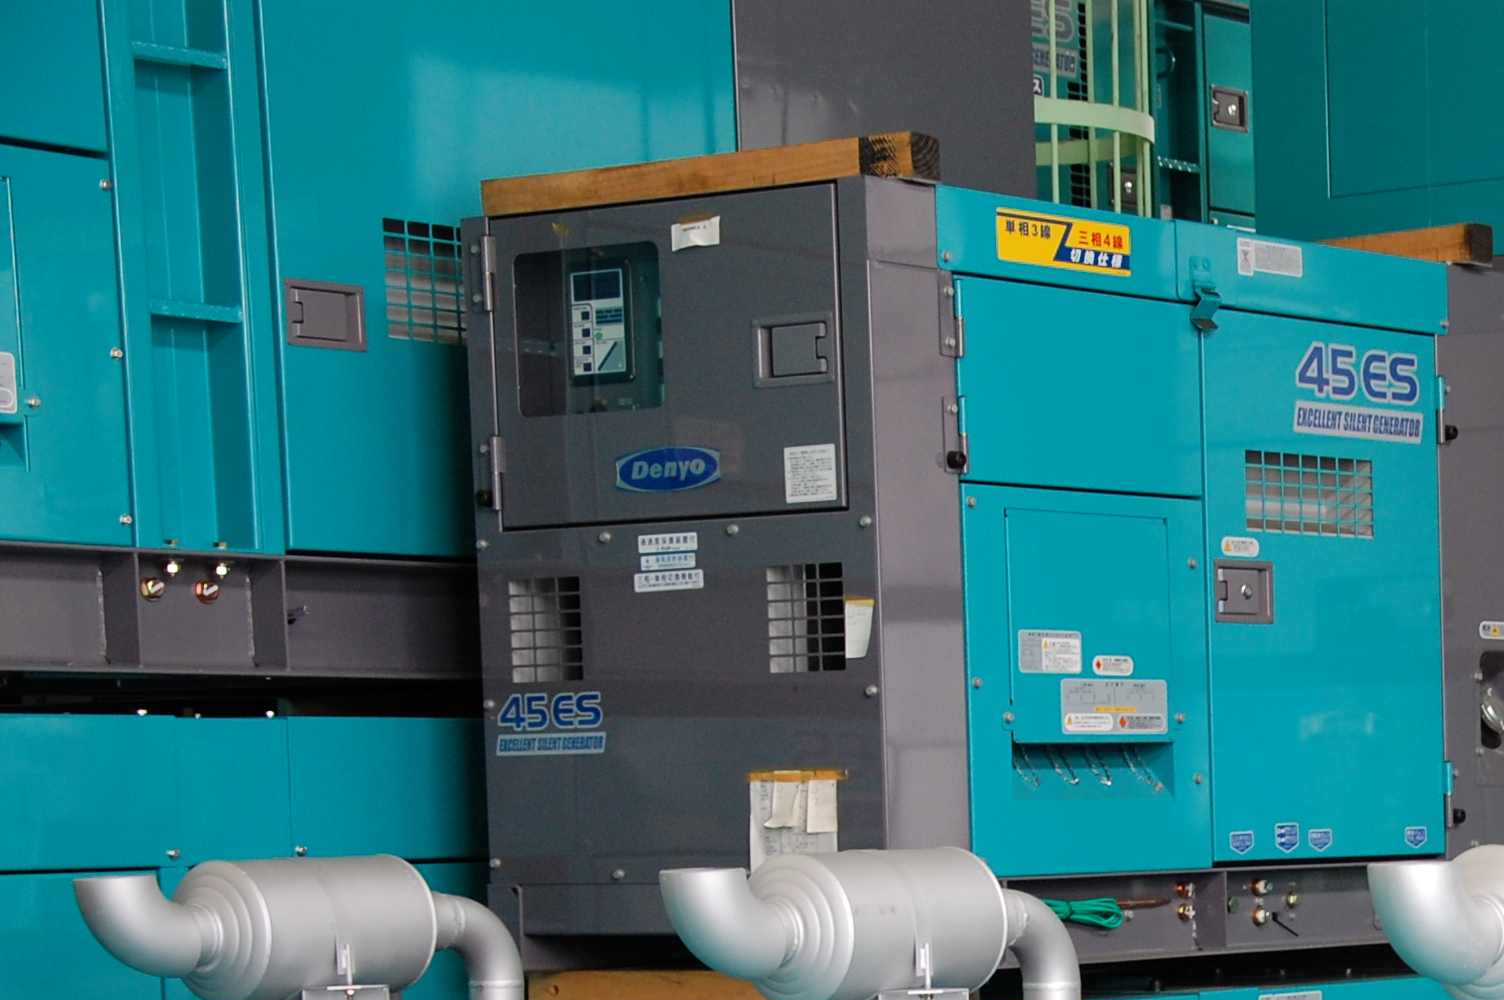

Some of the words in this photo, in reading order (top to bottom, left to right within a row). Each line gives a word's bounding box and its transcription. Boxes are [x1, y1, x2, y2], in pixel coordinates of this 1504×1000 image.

[1297, 407, 1343, 430] EXCELLENT
[1343, 411, 1373, 434] SILENT
[1373, 414, 1422, 438] GENERATOR
[631, 458, 706, 481] Denyo
